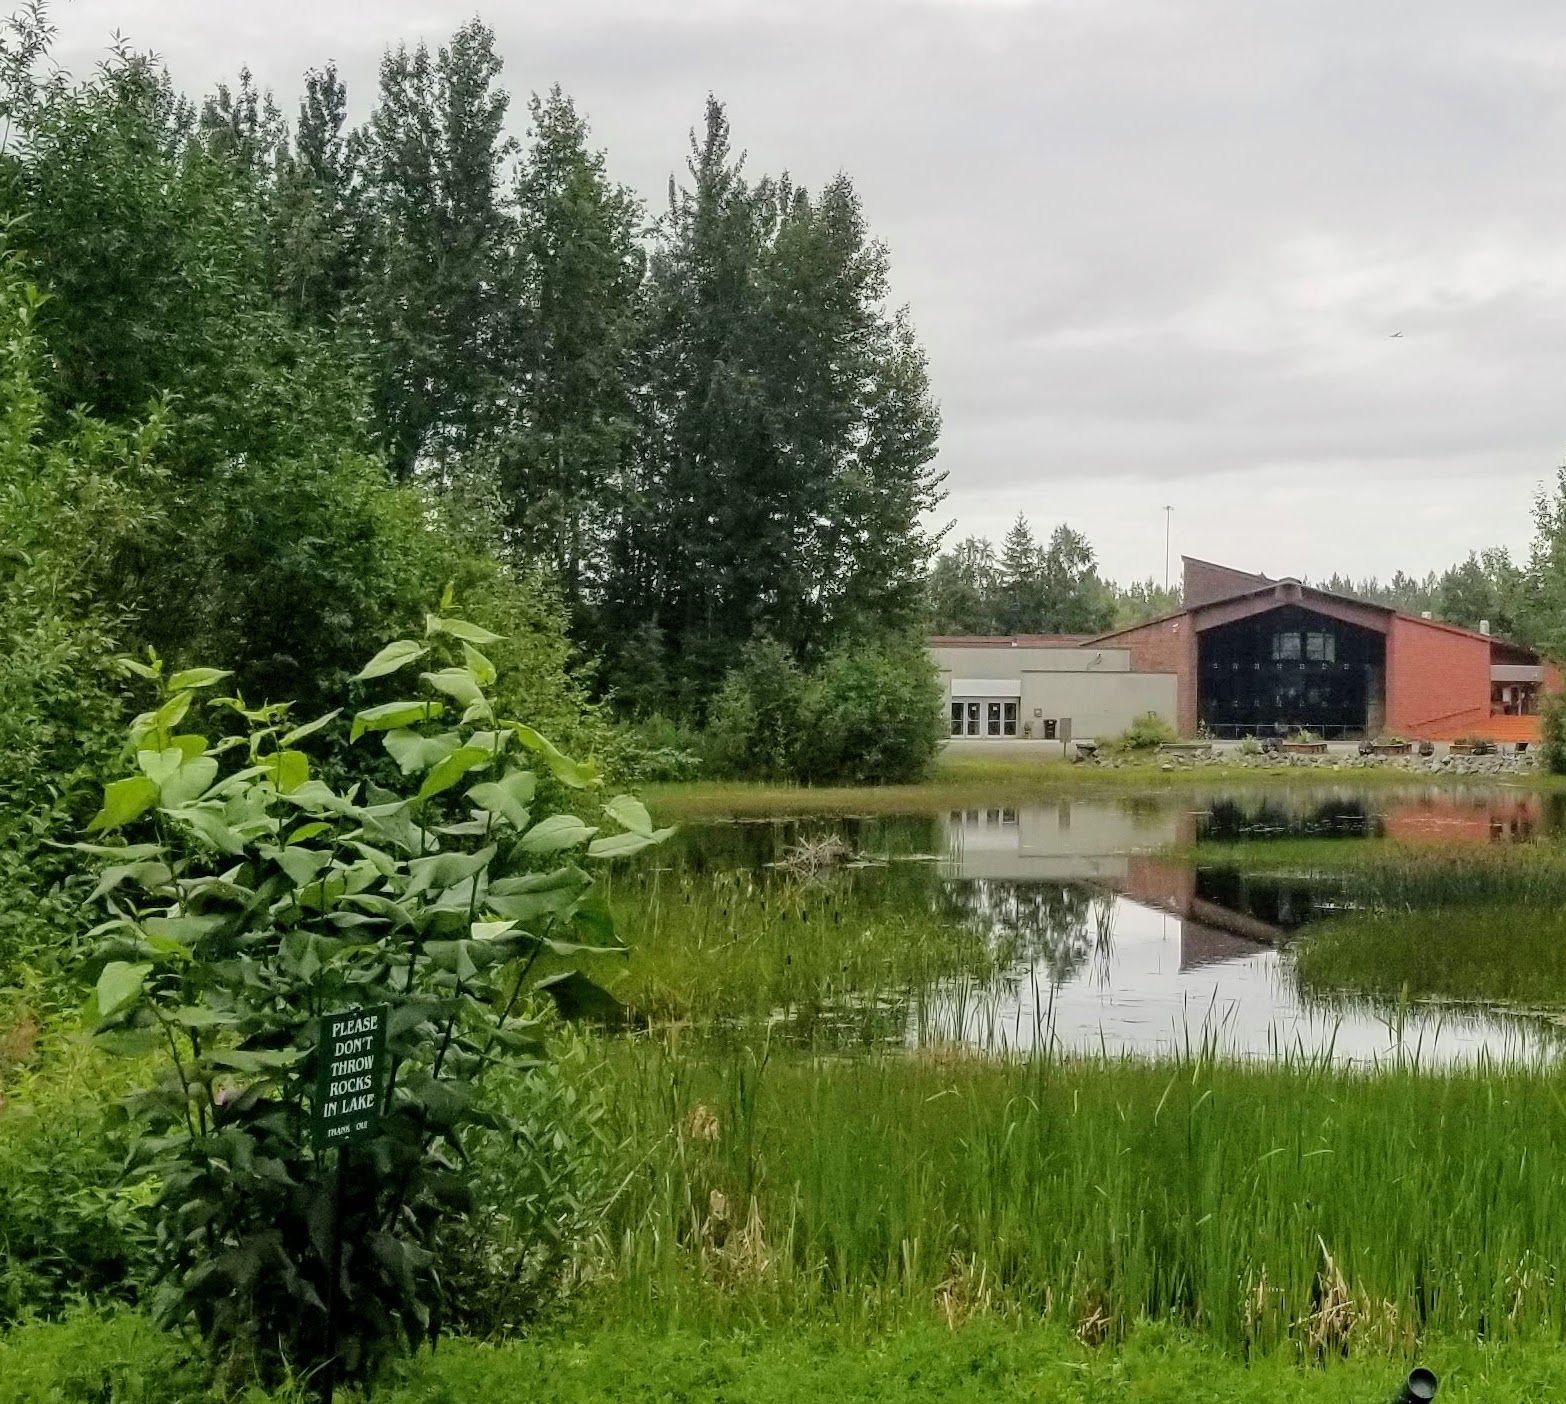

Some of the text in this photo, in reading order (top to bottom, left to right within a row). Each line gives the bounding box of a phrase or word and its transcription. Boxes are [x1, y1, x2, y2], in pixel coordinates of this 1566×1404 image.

[332, 1016, 378, 1037] PLEASE
[335, 1036, 373, 1056] DON'T
[331, 1056, 374, 1076] THROW
[330, 1075, 372, 1096] ROCKS
[323, 1094, 375, 1118] IN LAKE
[328, 1125, 351, 1137] THANK
